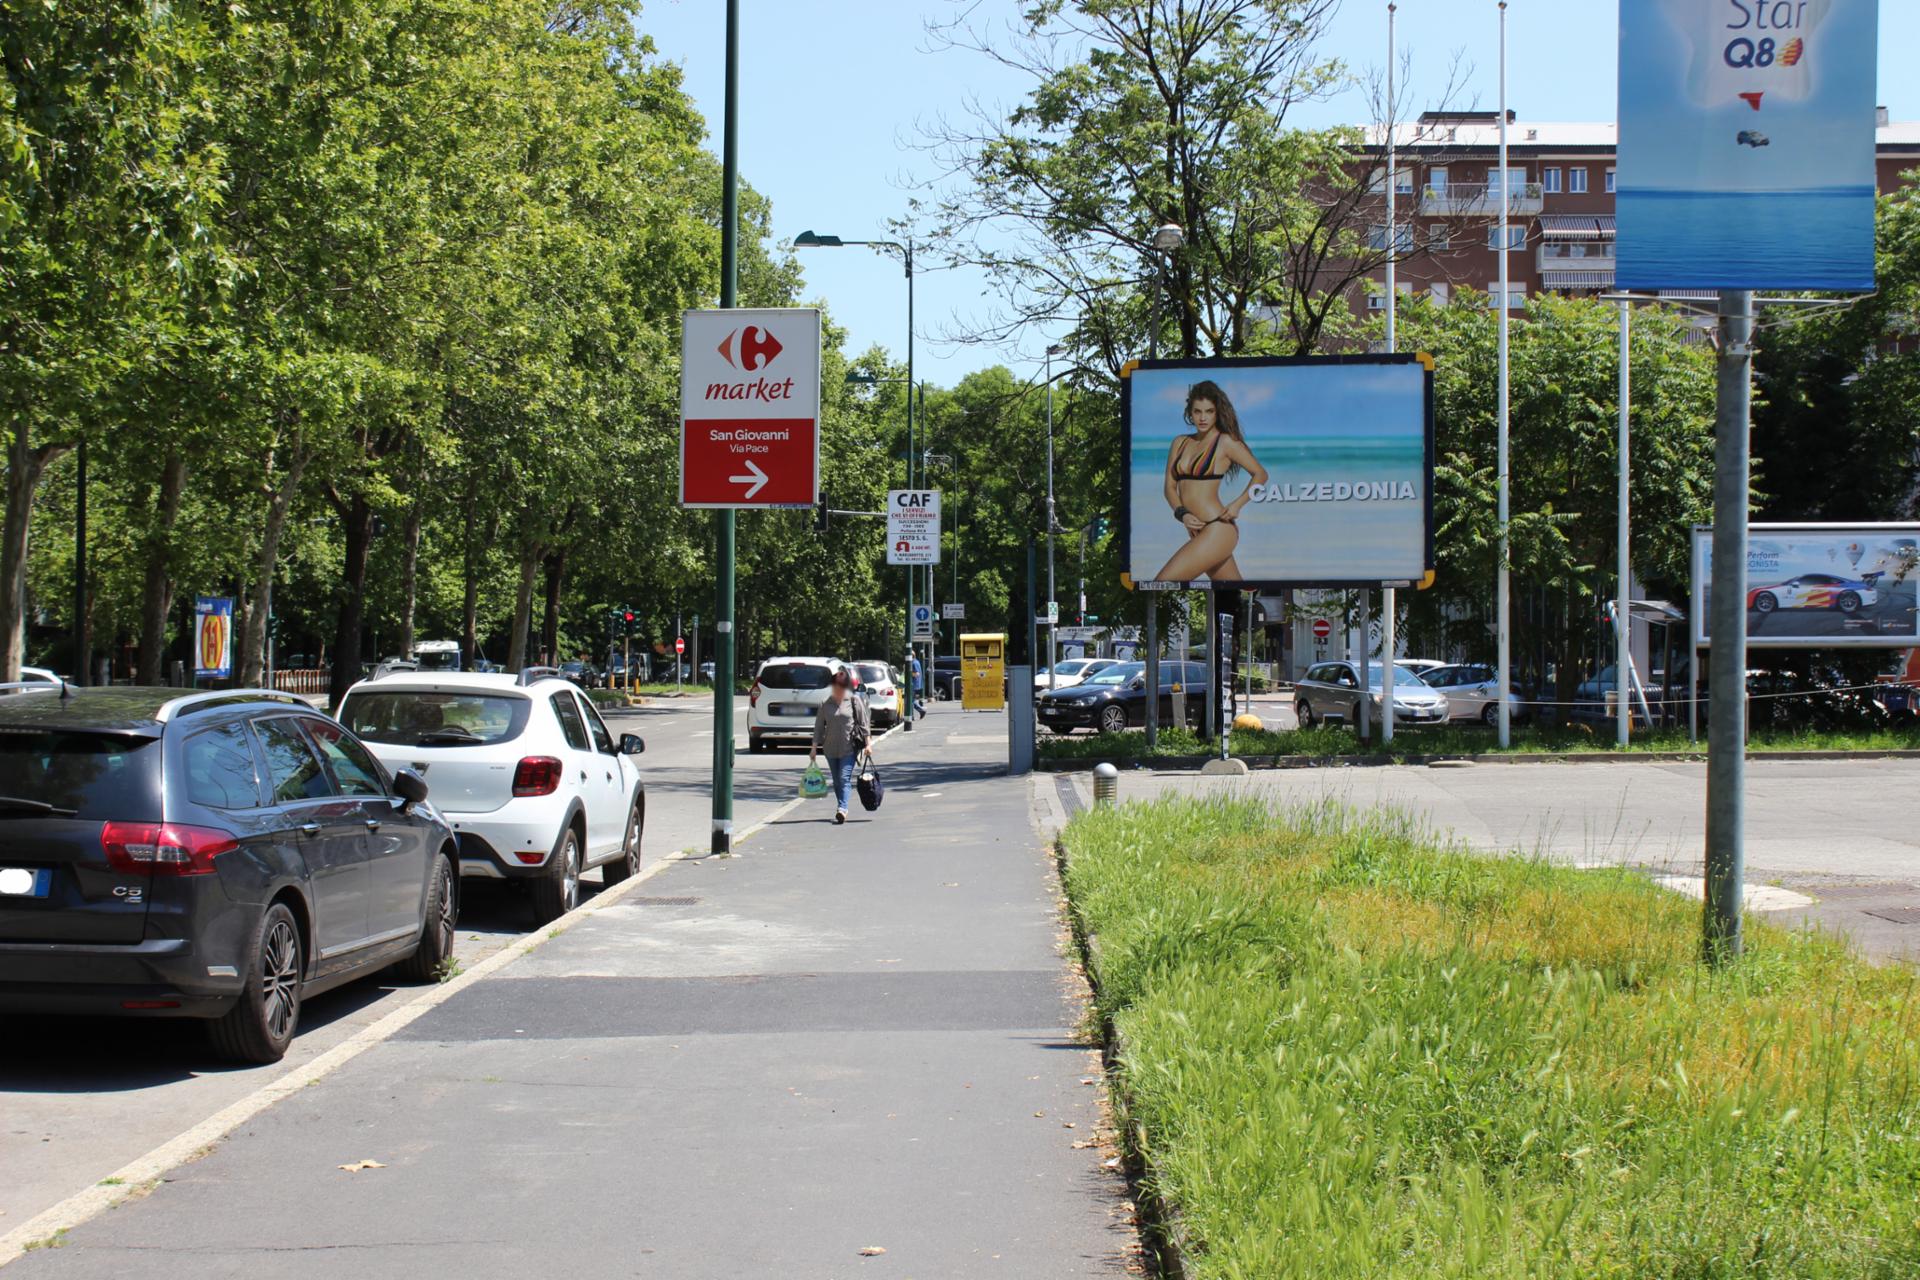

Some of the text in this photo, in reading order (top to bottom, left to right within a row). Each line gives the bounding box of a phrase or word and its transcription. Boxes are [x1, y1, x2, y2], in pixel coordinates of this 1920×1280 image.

[1726, 0, 1807, 30] Star
[1724, 37, 1776, 68] Q8
[705, 377, 795, 402] market
[710, 428, 789, 441] San Giovanni
[730, 444, 769, 453] Via Pace
[1249, 481, 1417, 503] CALZEDONIA
[897, 493, 931, 507] CAF
[1747, 552, 1780, 561] Perform
[112, 886, 142, 897] C5
